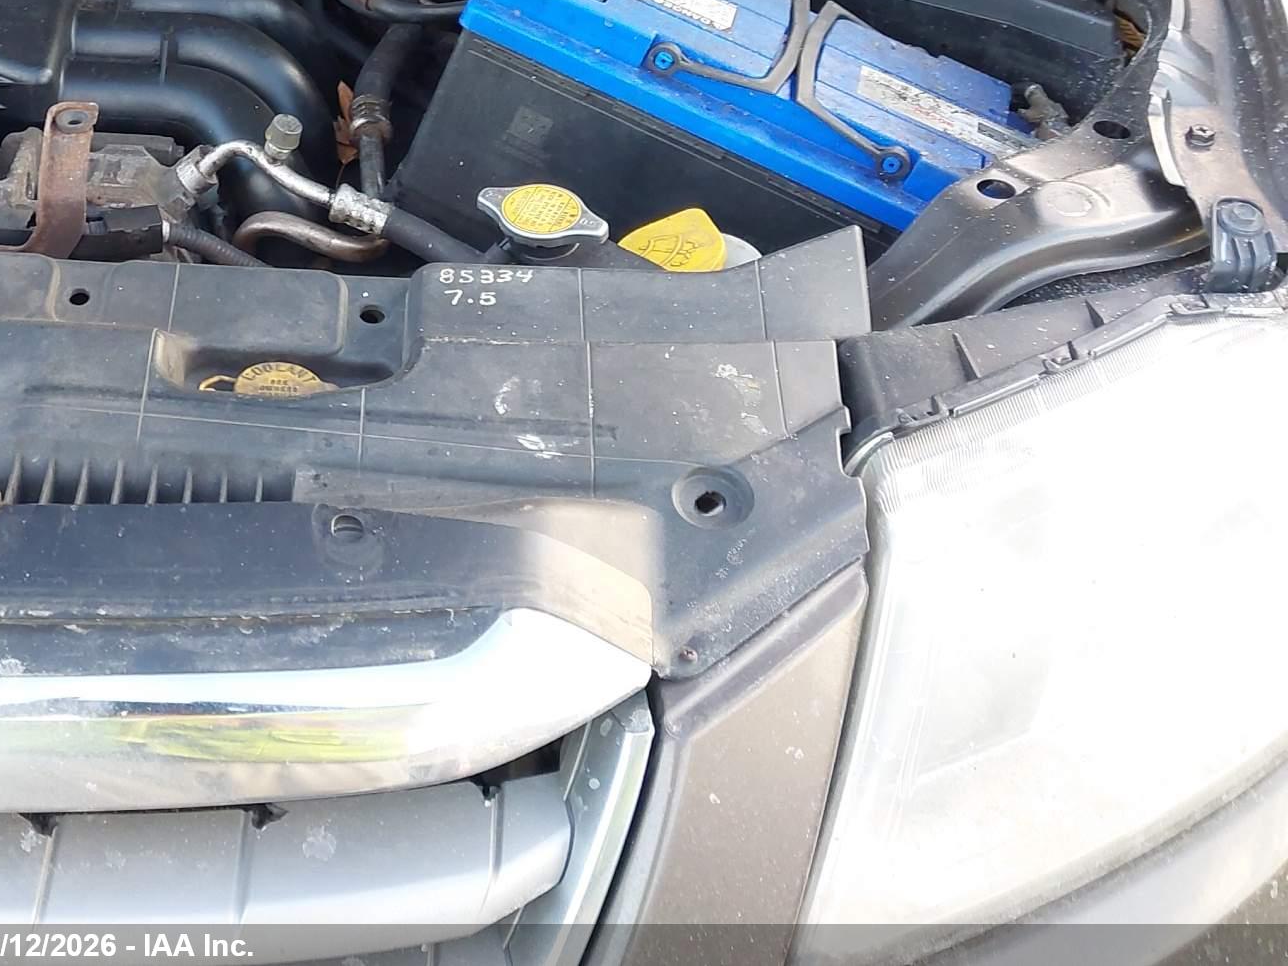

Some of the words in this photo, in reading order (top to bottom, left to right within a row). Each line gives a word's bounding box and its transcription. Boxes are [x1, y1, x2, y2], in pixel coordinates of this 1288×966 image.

[439, 268, 534, 284] 85334
[444, 289, 498, 306] 7.5
[241, 362, 317, 382] COOLANT
